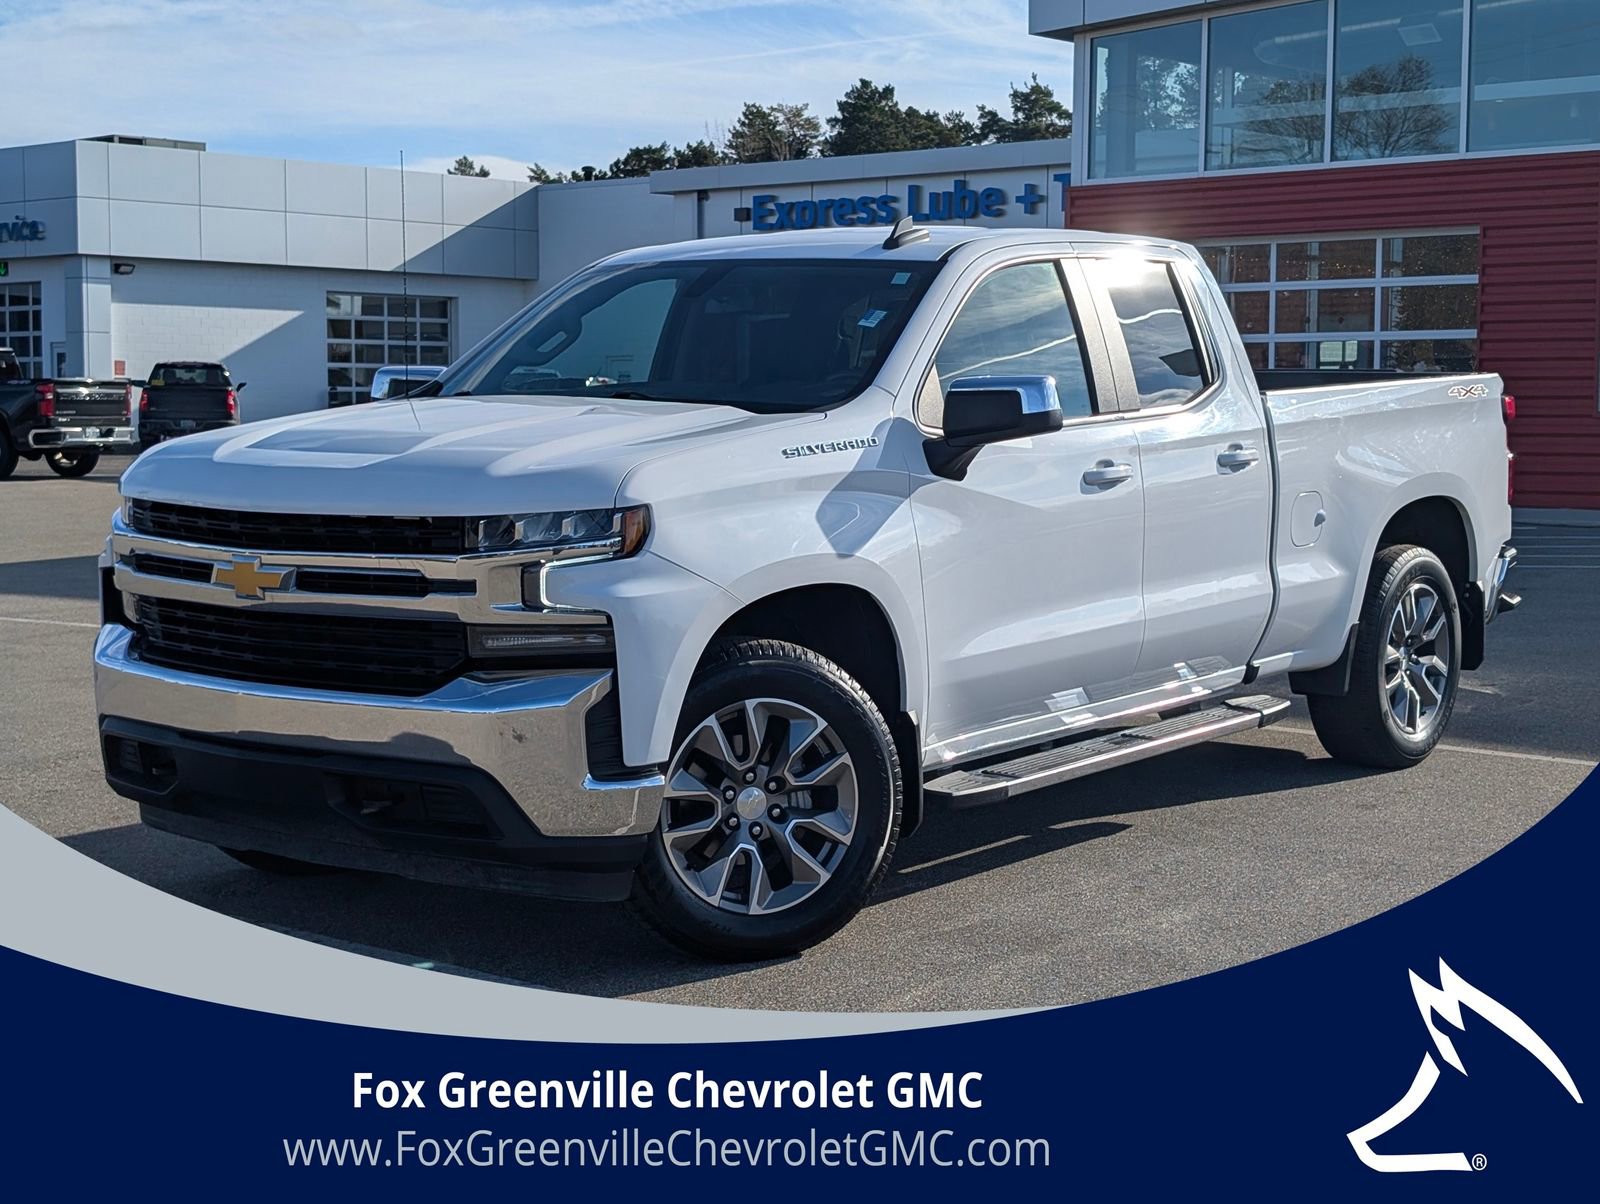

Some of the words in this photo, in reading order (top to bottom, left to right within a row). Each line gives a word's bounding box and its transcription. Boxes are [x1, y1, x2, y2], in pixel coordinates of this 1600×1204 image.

[753, 194, 898, 230] Express
[908, 179, 1008, 222] Lube
[781, 437, 879, 459] SILVERADO
